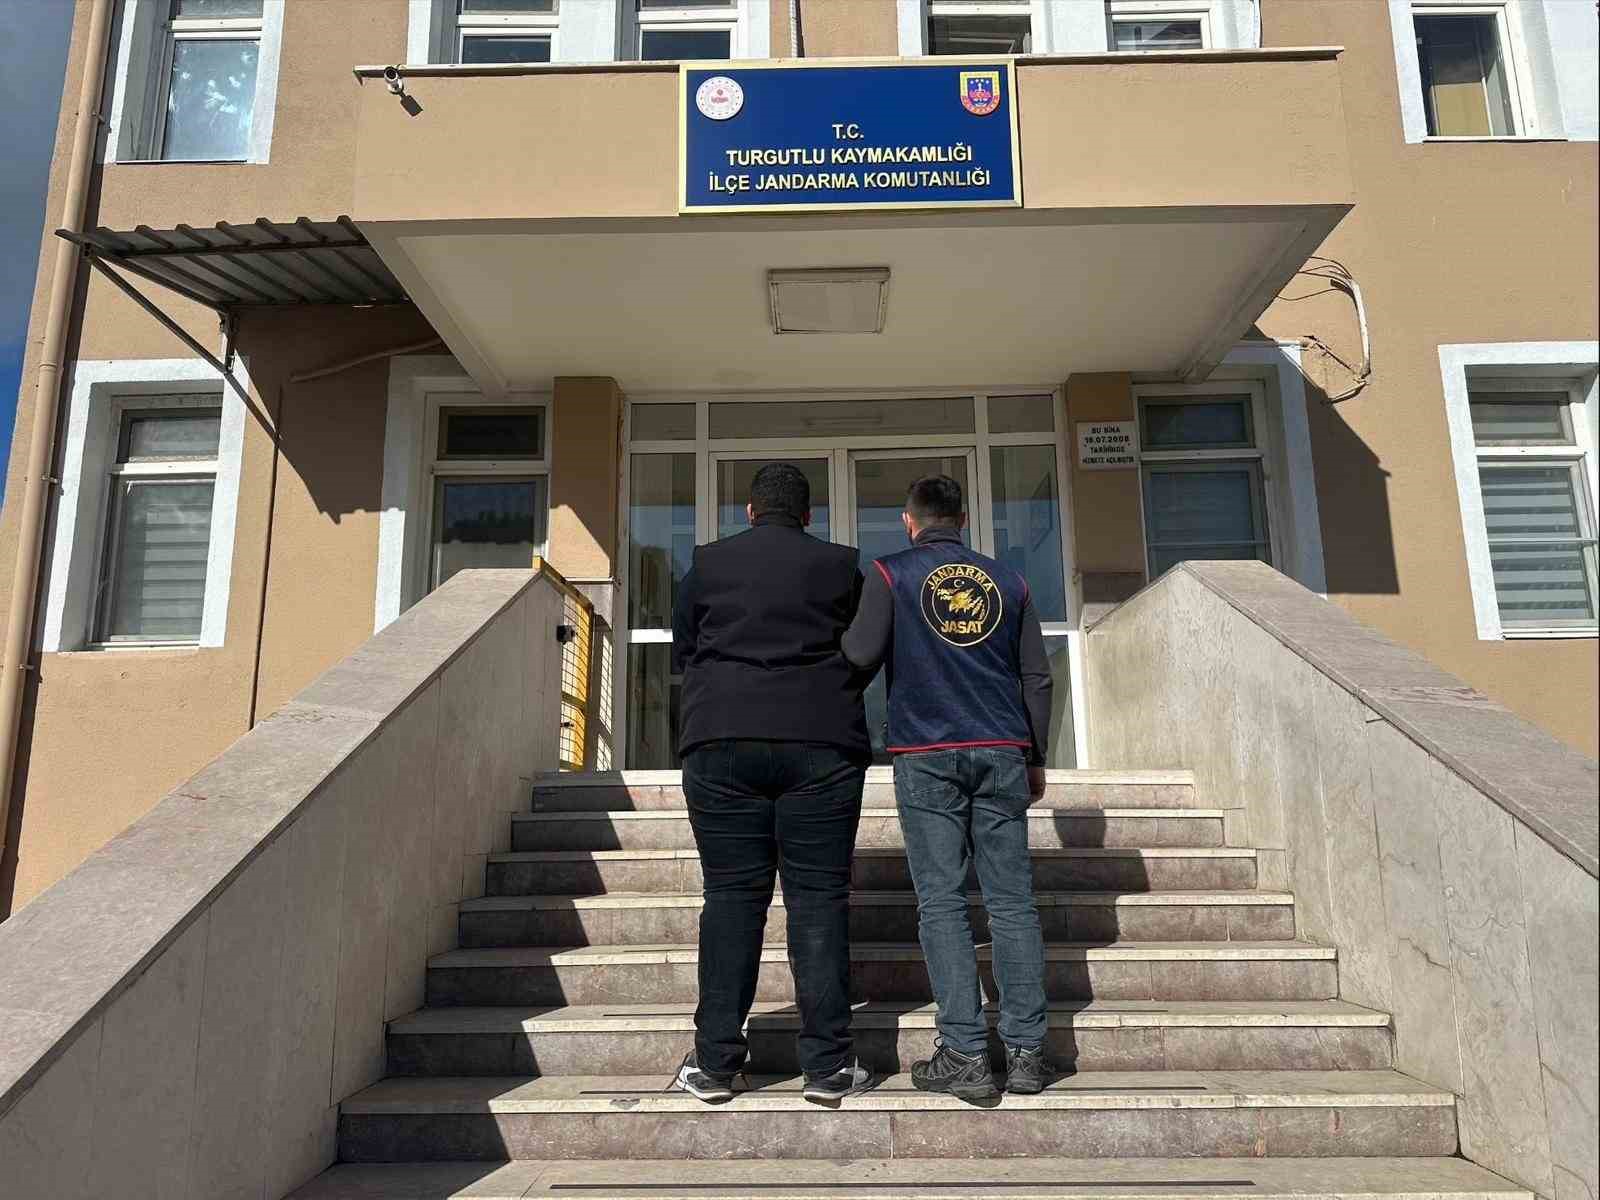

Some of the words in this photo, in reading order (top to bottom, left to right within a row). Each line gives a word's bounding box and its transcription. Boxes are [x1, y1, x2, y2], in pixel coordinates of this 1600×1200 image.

[832, 123, 864, 139] T.C.
[726, 148, 825, 166] TURGUTLU
[831, 142, 972, 164] KAYMAKAMLIĞI
[709, 171, 750, 194] İLÇE
[755, 173, 860, 191] JANDARMA
[864, 167, 991, 188] KOMUTANLIĞI
[928, 567, 993, 592] JANDARMA
[941, 620, 984, 634] JASAT
